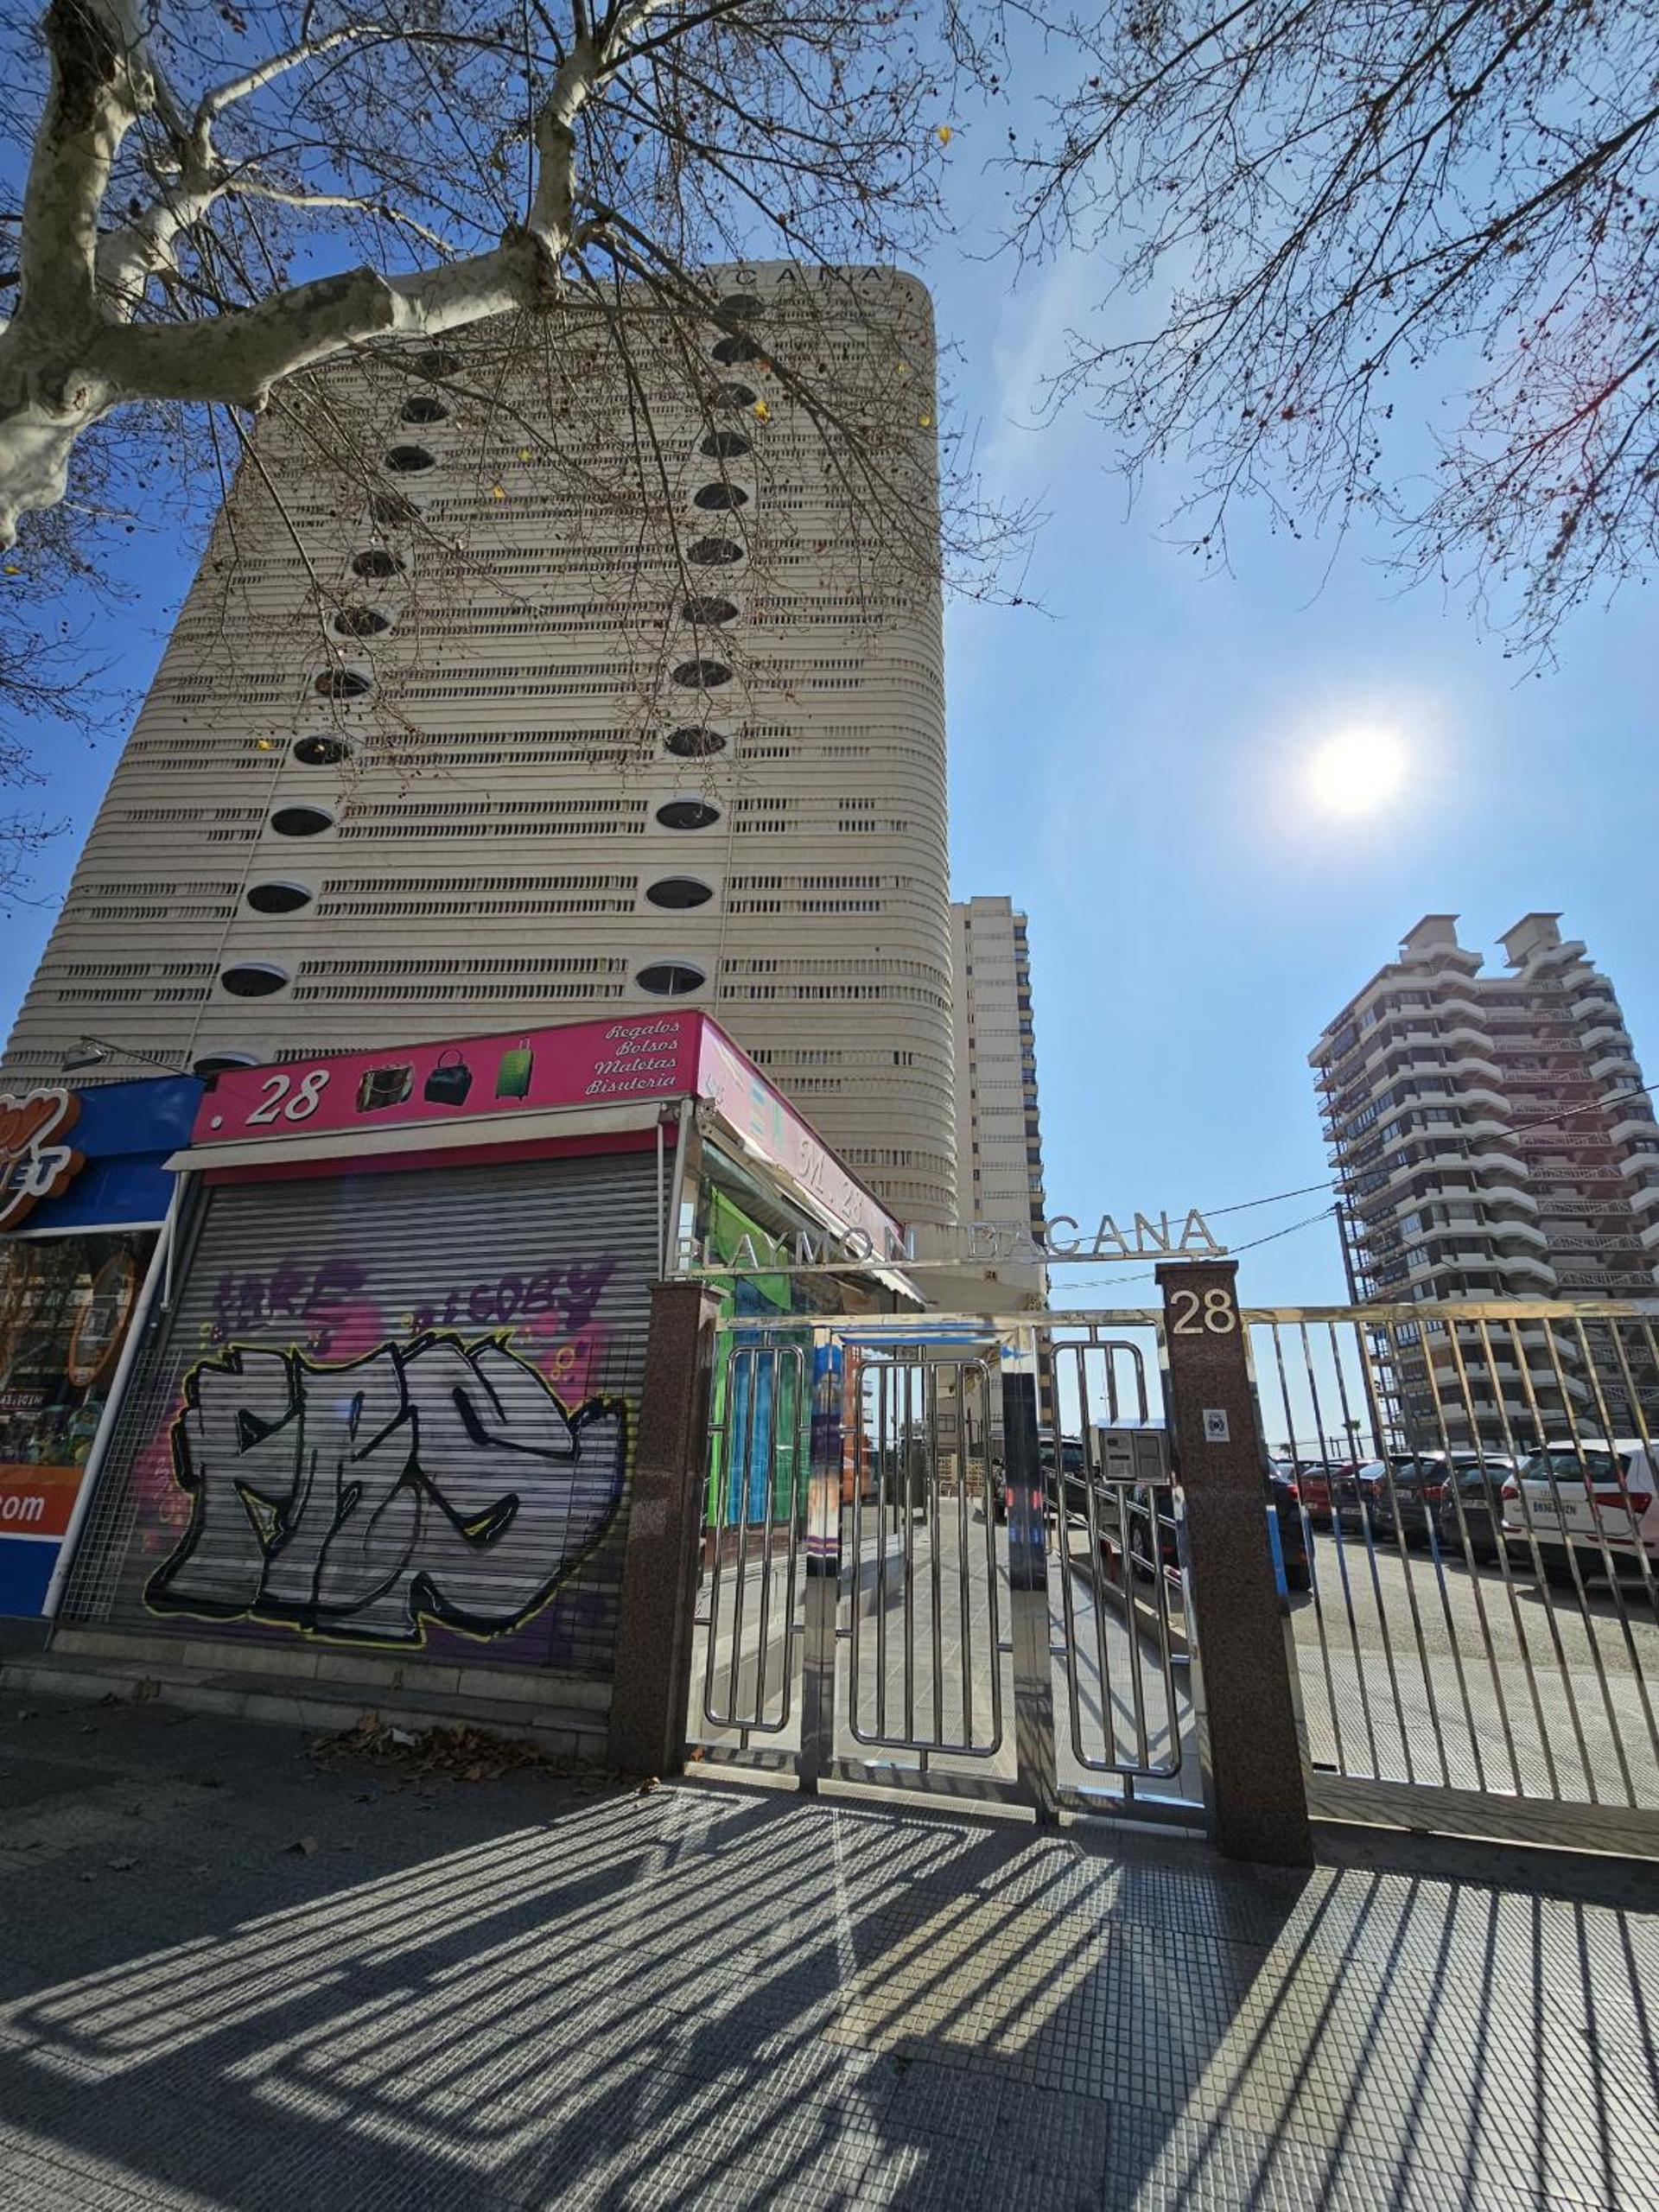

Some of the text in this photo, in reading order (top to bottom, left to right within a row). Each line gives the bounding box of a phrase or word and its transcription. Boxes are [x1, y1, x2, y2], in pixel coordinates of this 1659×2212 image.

[606, 1020, 681, 1039] Regalos
[615, 1039, 678, 1056] Bolsos
[594, 1058, 677, 1075] Maletas
[1170, 1288, 1236, 1335] 28
[0, 1496, 45, 1521] om
